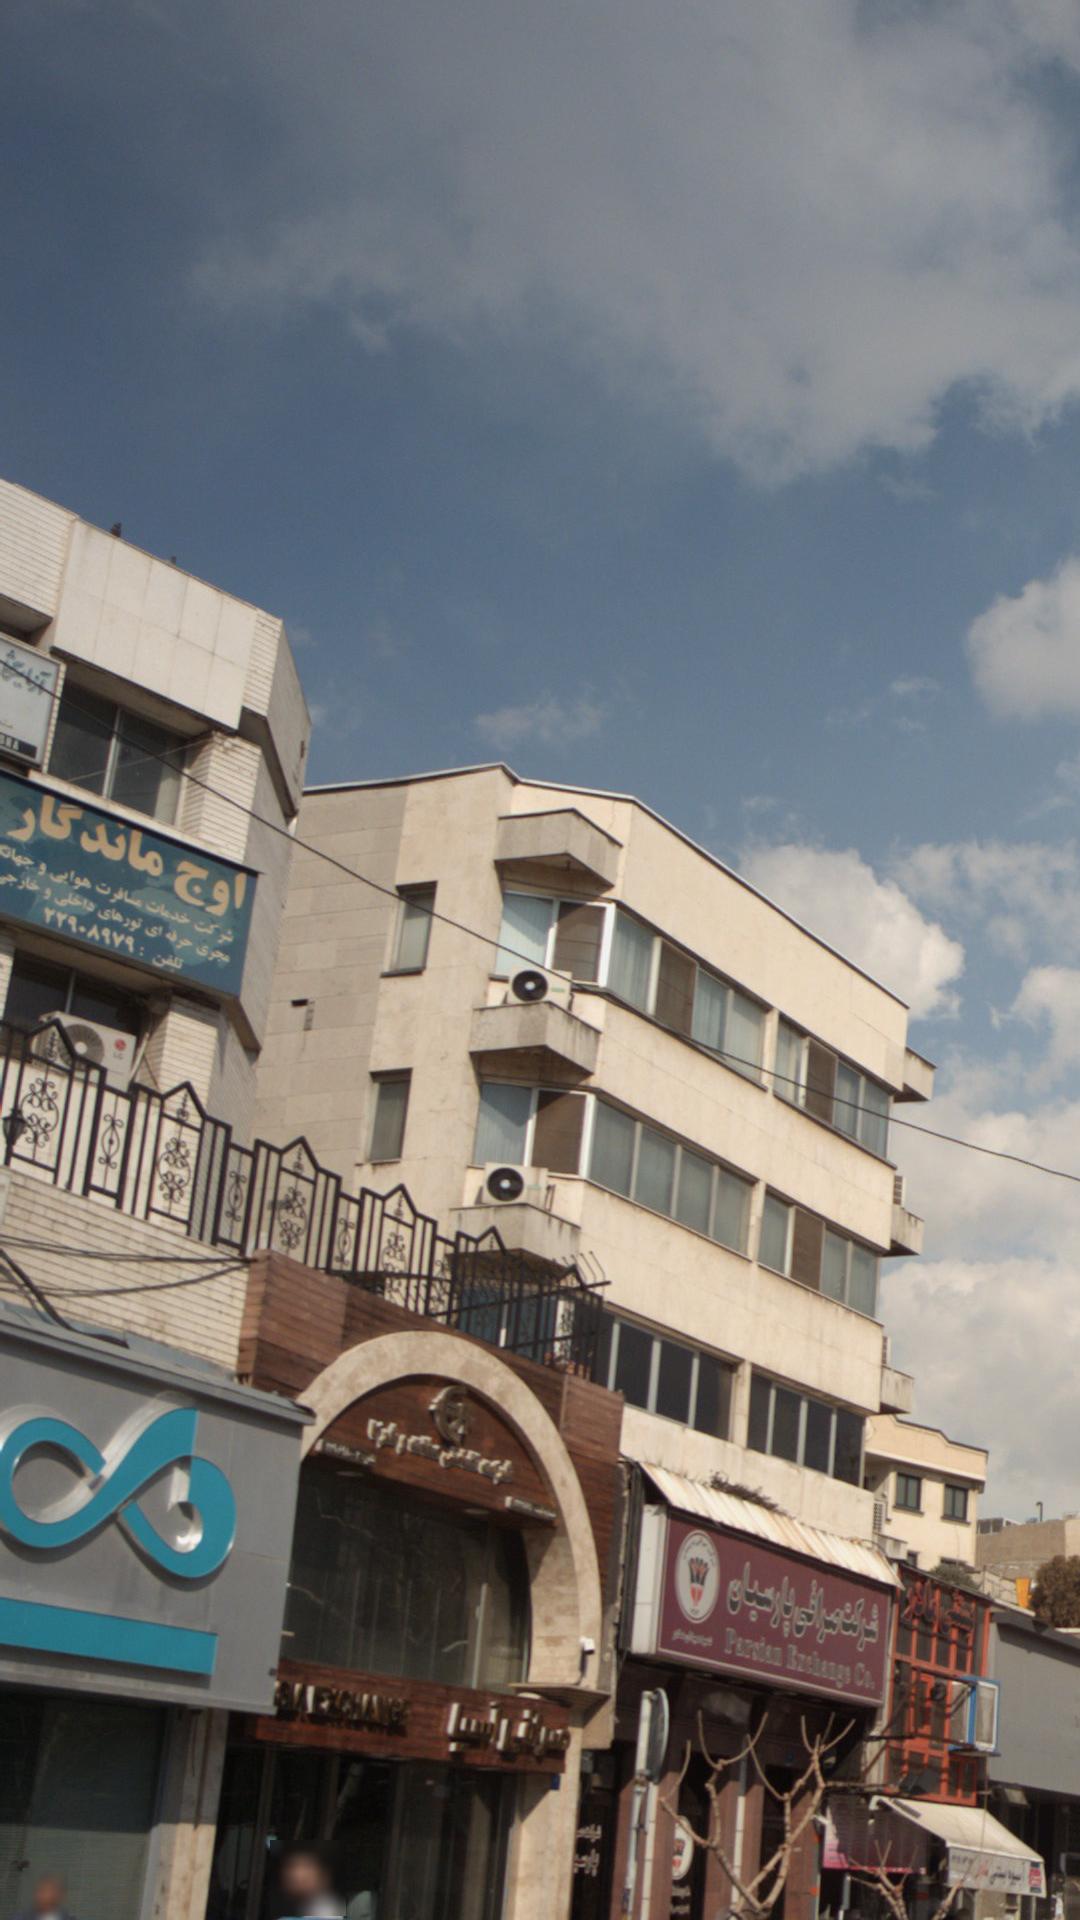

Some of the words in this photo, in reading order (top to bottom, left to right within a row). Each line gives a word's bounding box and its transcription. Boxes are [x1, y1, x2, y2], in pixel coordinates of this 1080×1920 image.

[6, 794, 163, 877] ماندگار
[54, 892, 96, 913] داخلی
[174, 860, 247, 917] اوج
[97, 906, 143, 932] تورهای
[145, 902, 191, 924] خدمات
[194, 921, 234, 944] شرکت
[151, 954, 183, 970] تلفن
[195, 945, 231, 964] مجری
[727, 1561, 794, 1638] پارسیان
[793, 1579, 842, 1644] صرافی
[841, 1598, 879, 1652] شرکت
[724, 1627, 782, 1666] Parsian
[786, 1644, 851, 1689] Exchange
